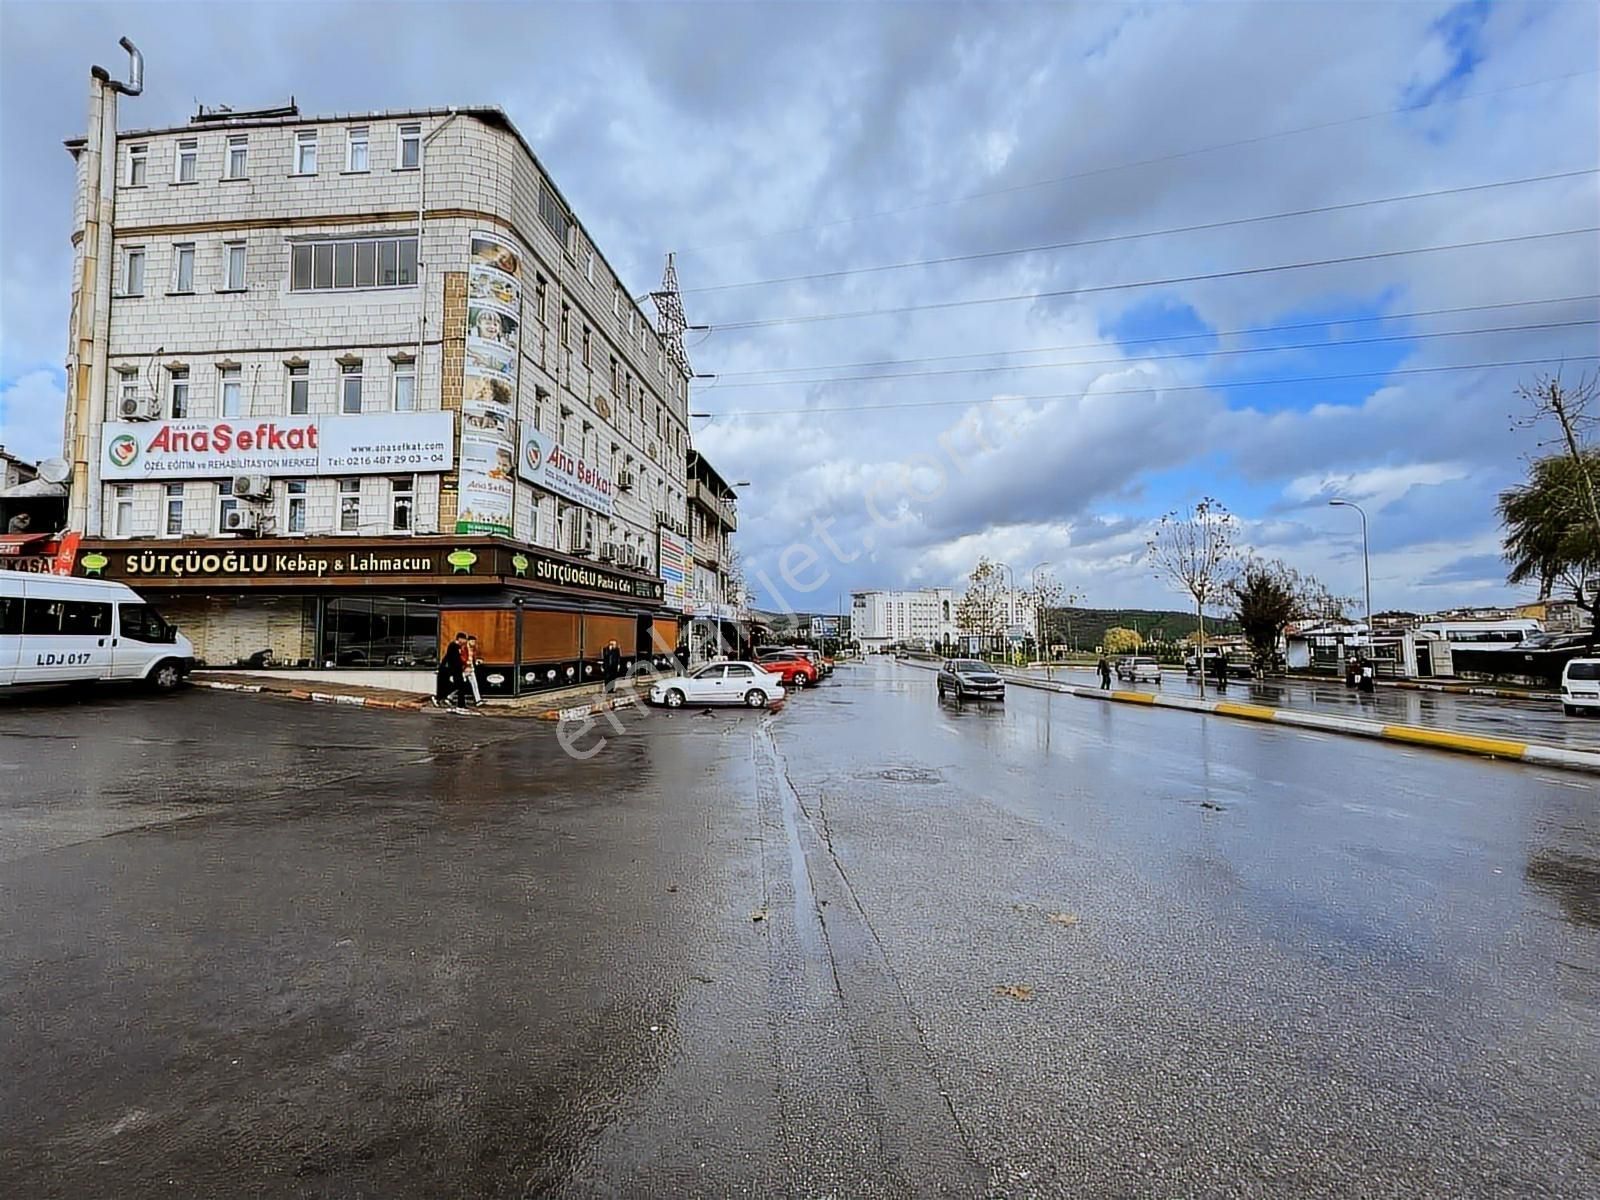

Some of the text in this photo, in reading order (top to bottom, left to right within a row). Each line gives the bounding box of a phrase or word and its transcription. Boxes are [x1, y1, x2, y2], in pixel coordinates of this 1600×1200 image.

[351, 441, 444, 453] www.anasefkat.com
[144, 459, 165, 471] ÖZEL
[167, 458, 195, 471] EĞİTİM
[208, 457, 279, 469] REHABİLİTASYON
[346, 456, 371, 466] 0216
[373, 455, 391, 465] 487
[394, 455, 406, 464] 29
[408, 454, 421, 463] 03
[430, 454, 443, 463] 04
[546, 444, 574, 476] Ana
[127, 551, 432, 577] SÜTÇÜOĞLU Kebap & Lahmacun
[537, 559, 596, 586] SÜTÇÜOĞLU
[37, 653, 91, 666] LDJ 017
